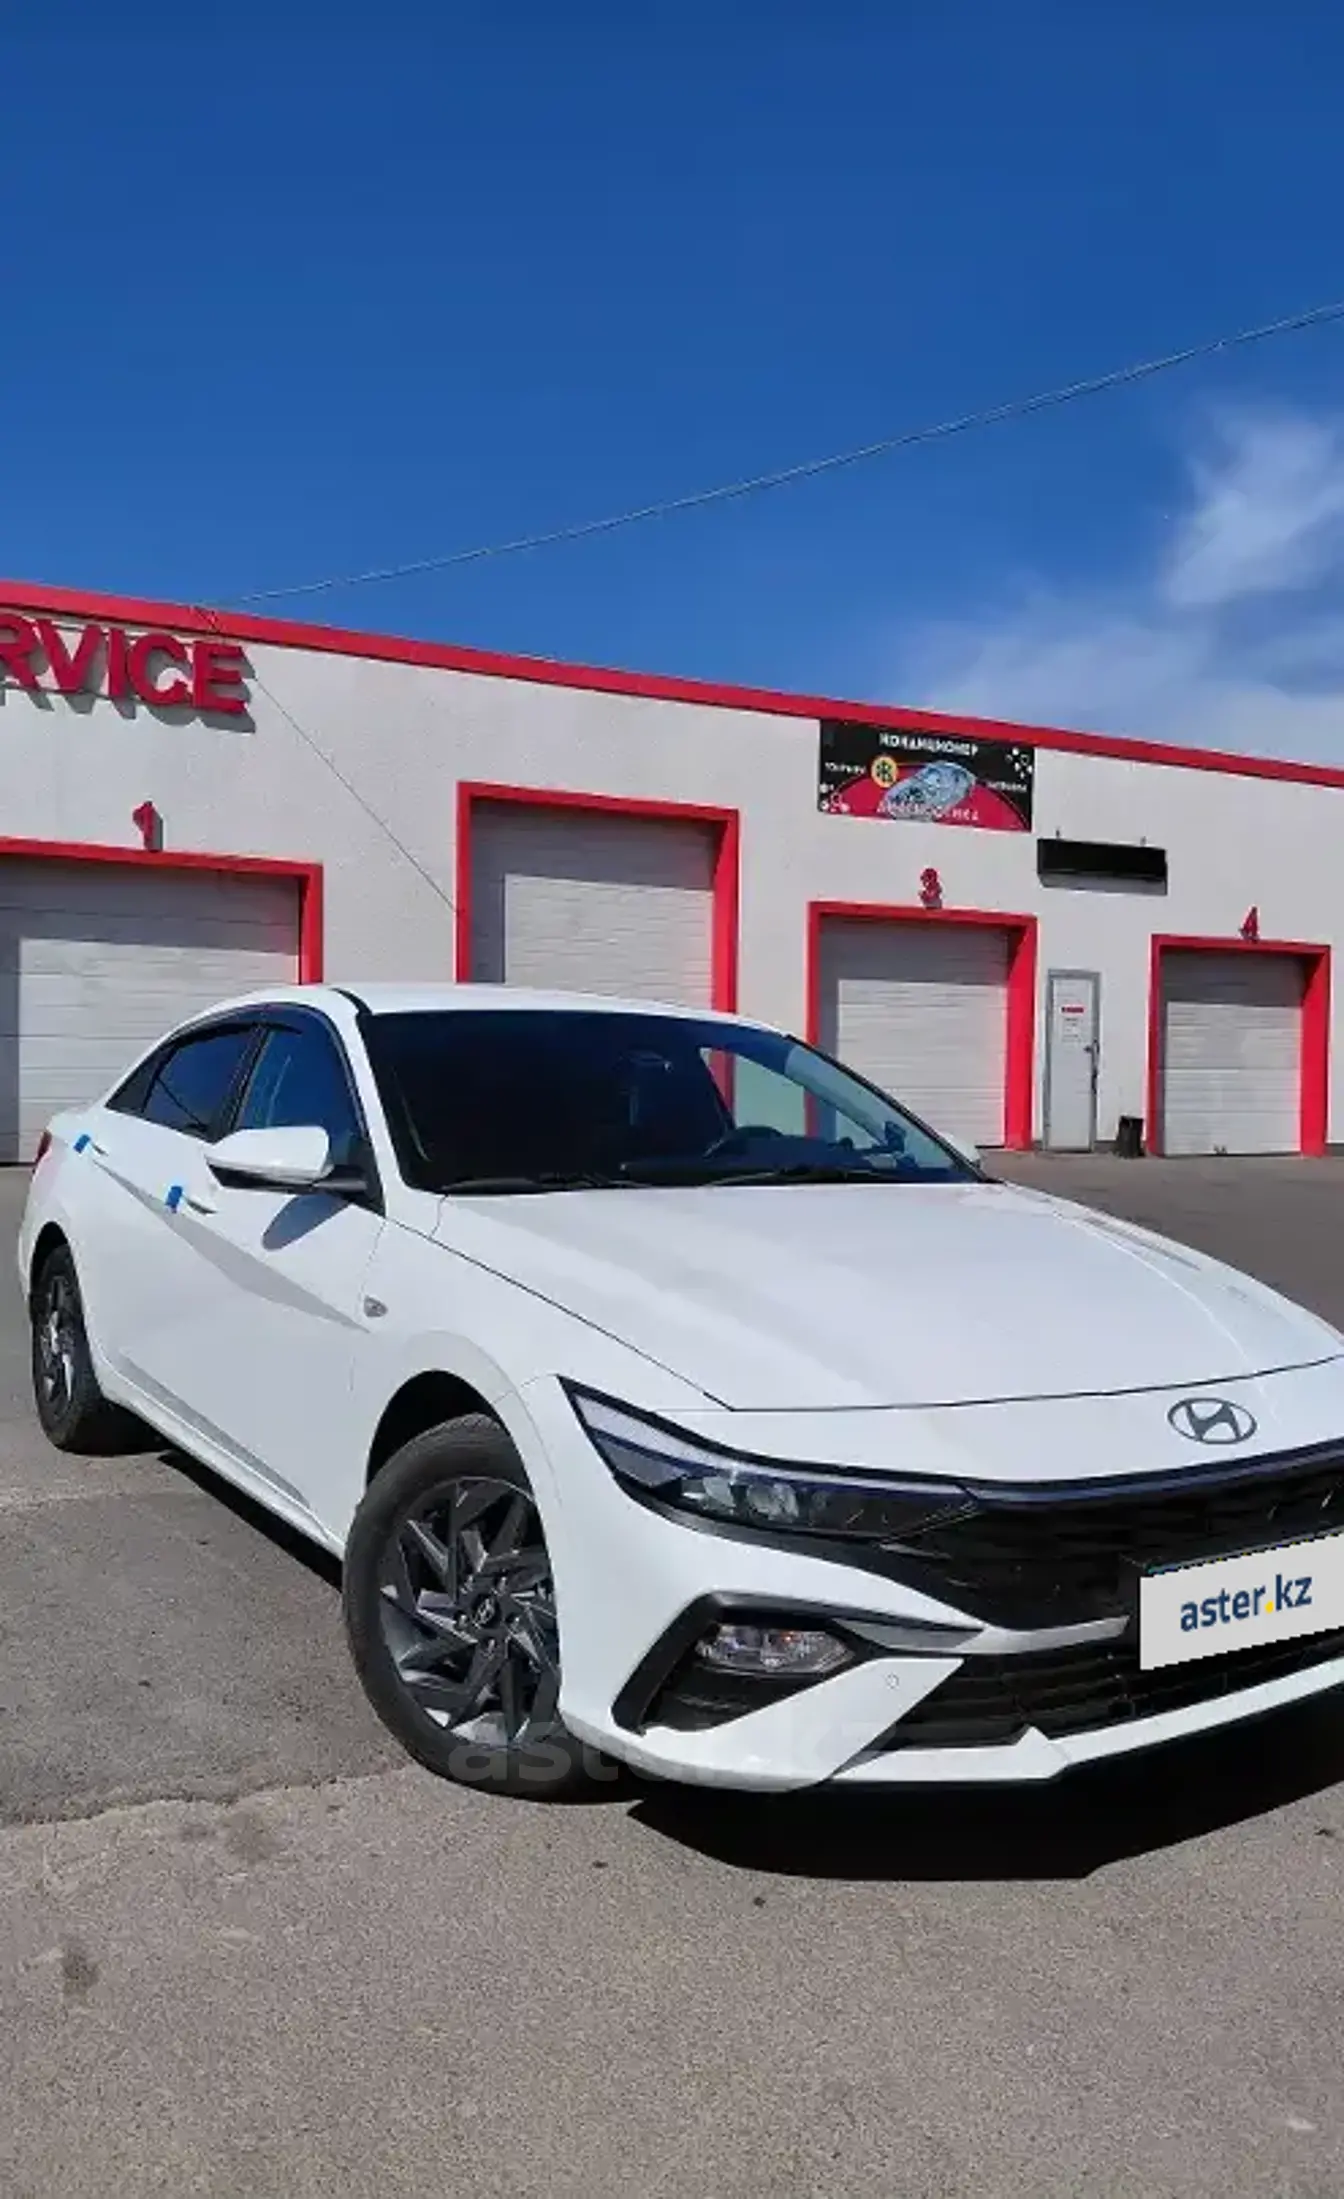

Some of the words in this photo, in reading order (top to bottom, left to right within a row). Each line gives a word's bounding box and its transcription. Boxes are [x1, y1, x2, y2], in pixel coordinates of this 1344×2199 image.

[0, 614, 247, 715] RVICE
[132, 801, 157, 850] 1
[1239, 906, 1258, 939] 4
